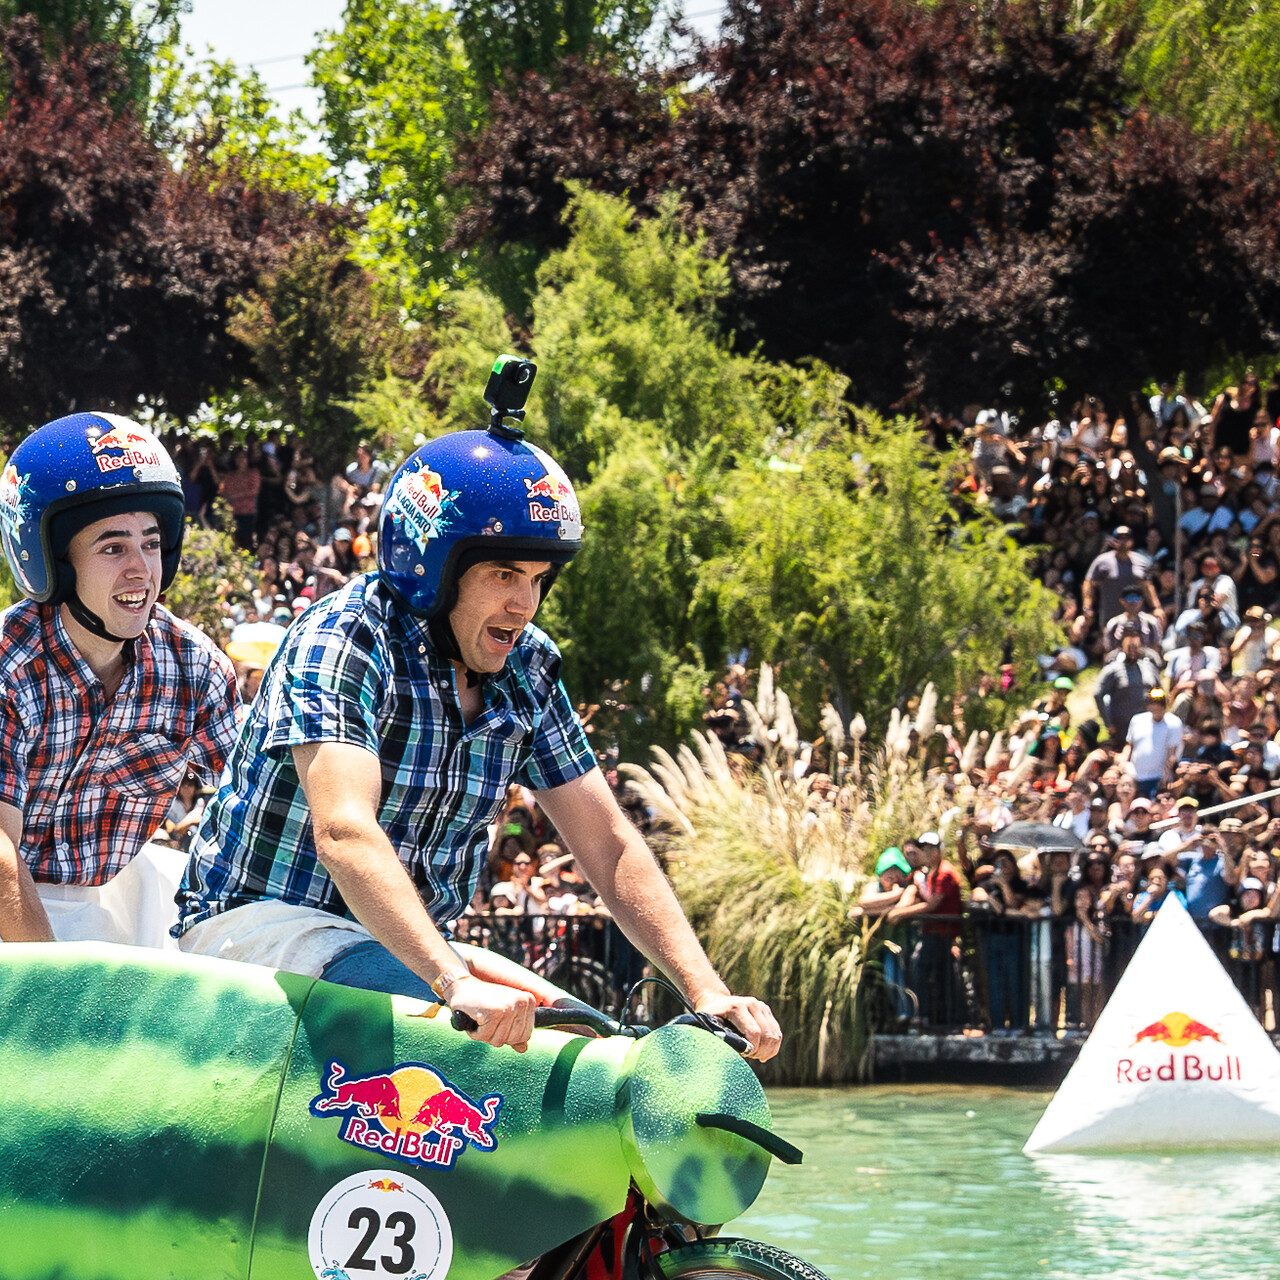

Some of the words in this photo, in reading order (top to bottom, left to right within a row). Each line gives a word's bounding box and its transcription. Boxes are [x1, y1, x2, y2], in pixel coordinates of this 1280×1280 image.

[98, 450, 133, 472] Red
[133, 451, 161, 466] Bull
[406, 477, 422, 500] Red
[417, 494, 439, 519] Bull
[531, 503, 560, 520] Red
[1116, 1054, 1175, 1083] Red
[1184, 1055, 1242, 1081] Bull
[346, 1117, 402, 1155] Red
[344, 1207, 417, 1275] 23
